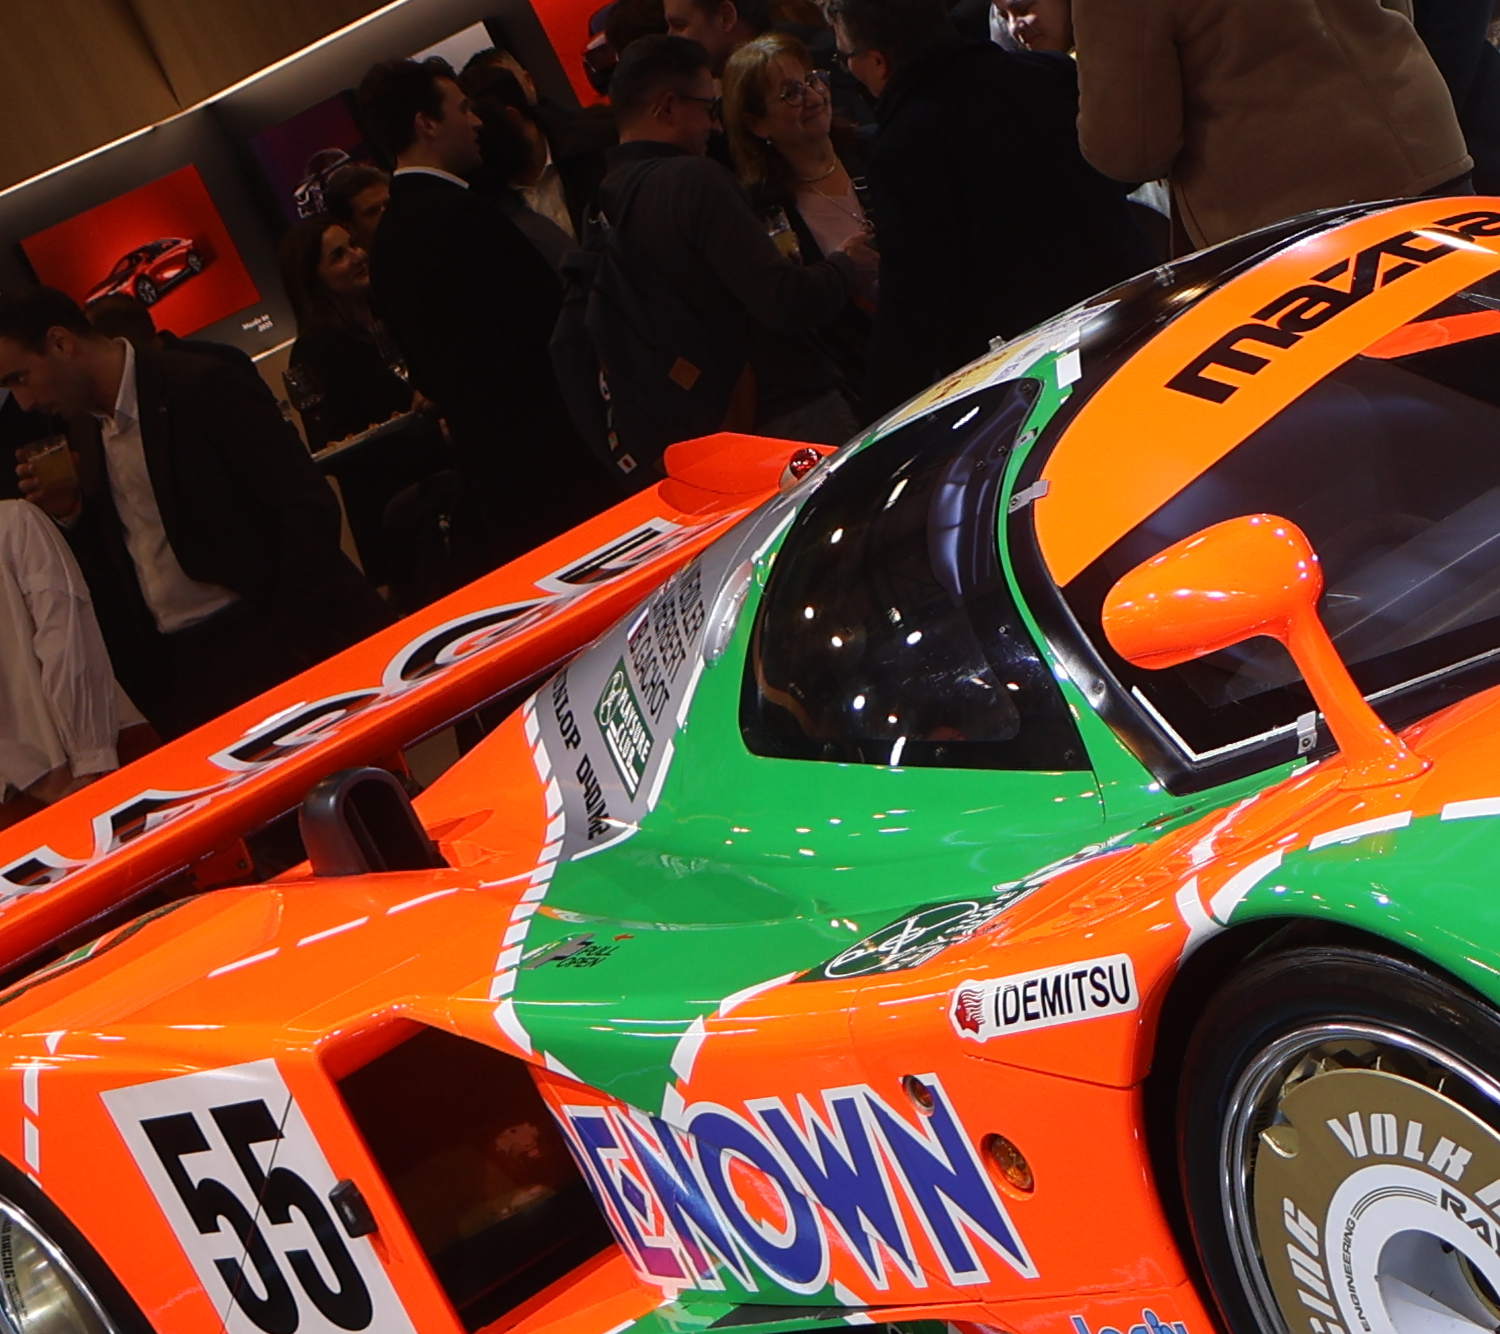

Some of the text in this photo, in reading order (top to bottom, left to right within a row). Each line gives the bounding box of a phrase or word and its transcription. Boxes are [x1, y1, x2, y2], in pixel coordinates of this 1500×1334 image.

[995, 962, 1132, 1027] IDEMITSU
[1326, 1111, 1474, 1182] VOLK
[1341, 1216, 1373, 1334] ENGINEERING
